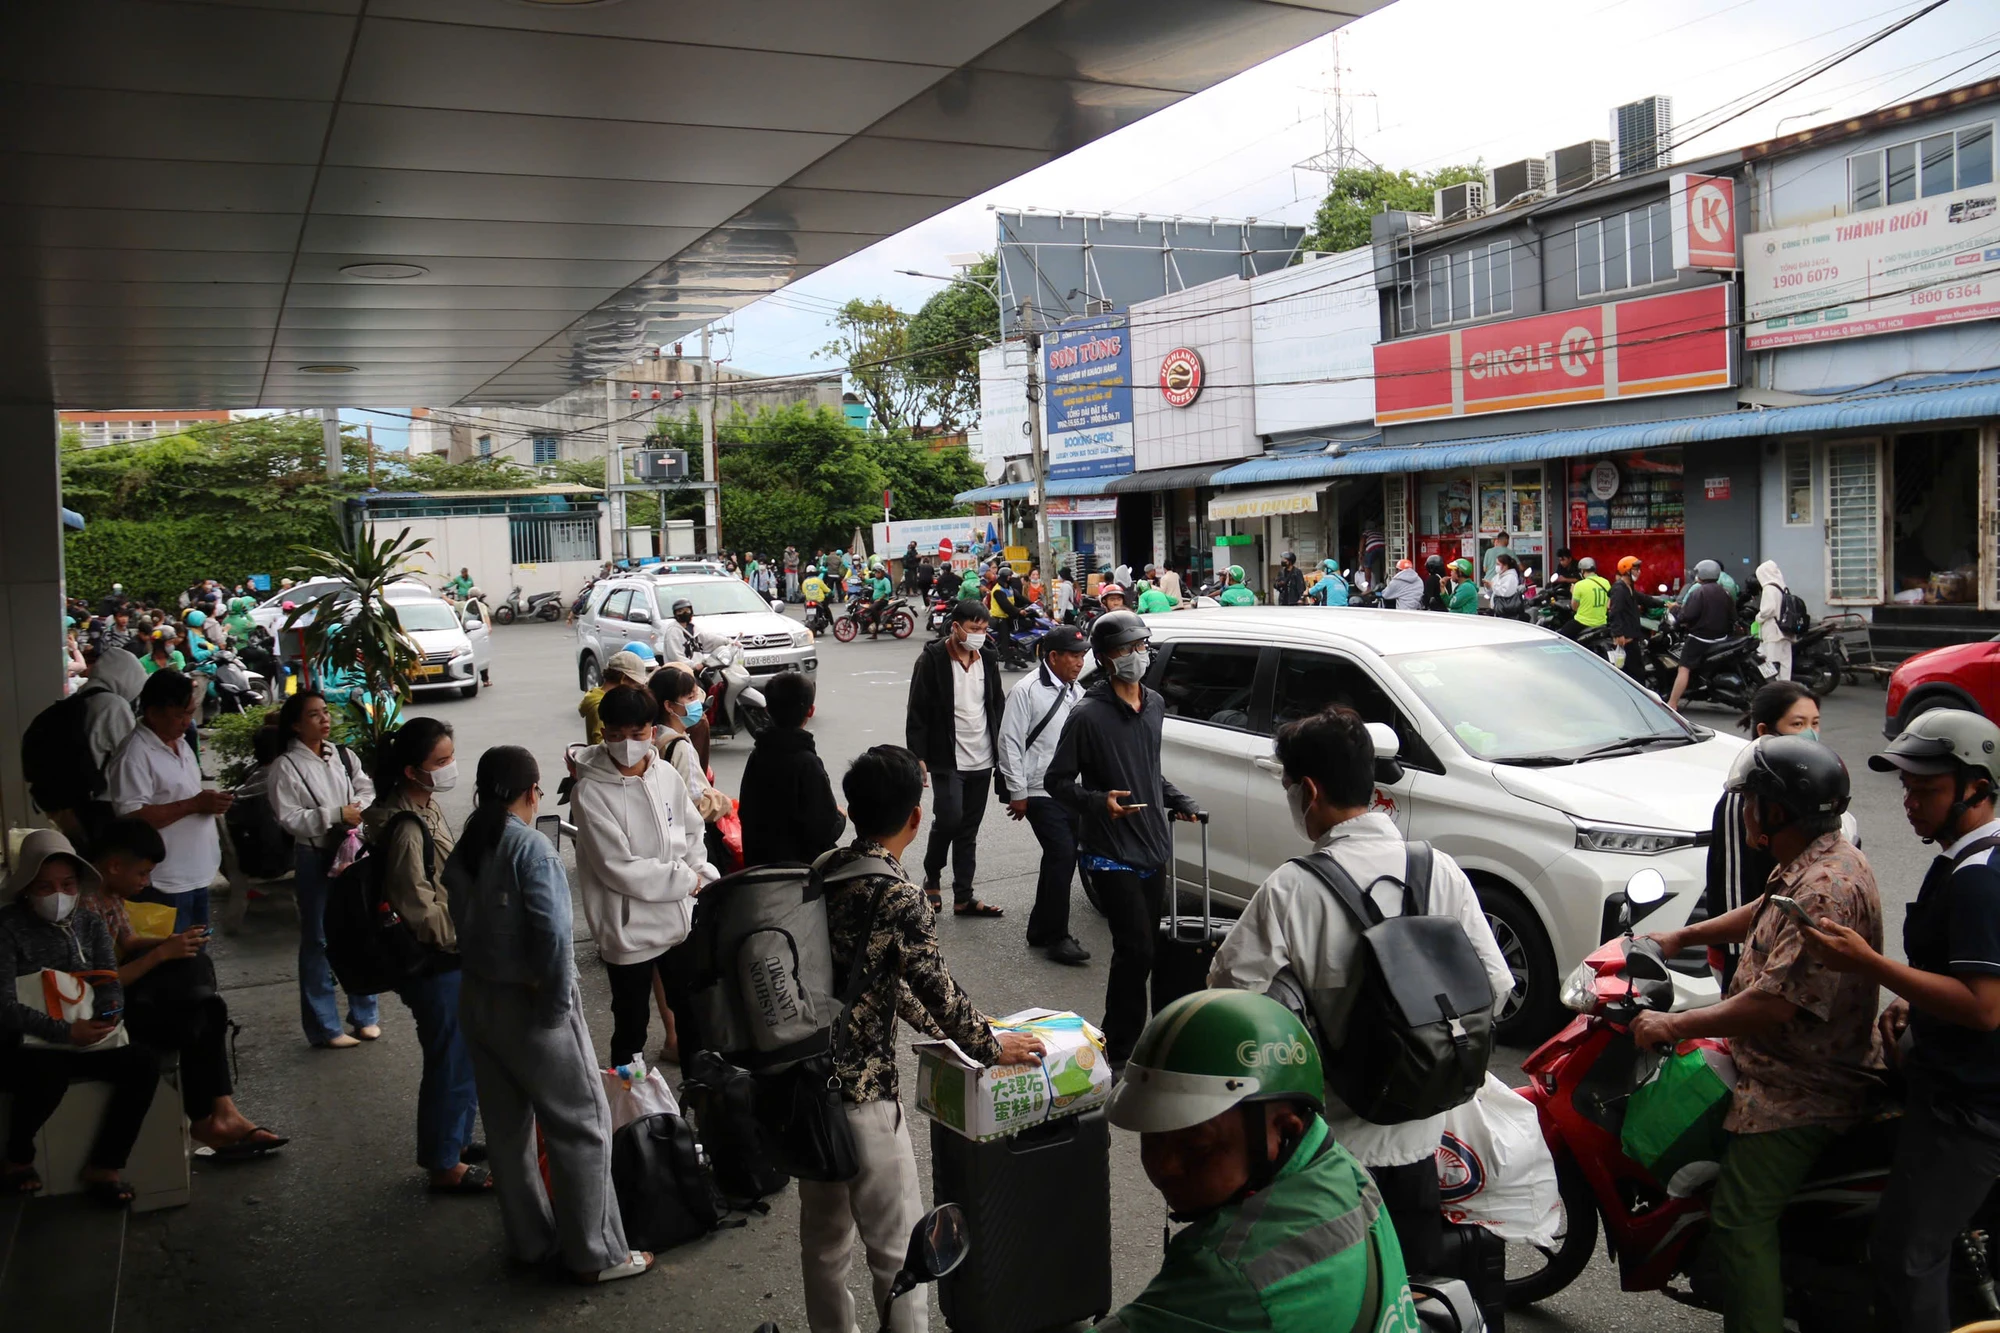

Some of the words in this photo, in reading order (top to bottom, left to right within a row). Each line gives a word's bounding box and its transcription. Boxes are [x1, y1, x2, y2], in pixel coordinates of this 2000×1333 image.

[1836, 219, 1885, 242] THÀNH
[1889, 207, 1929, 232] BƯỞI
[1773, 272, 1803, 289] 1900
[1807, 266, 1839, 283] 6079
[1910, 290, 1942, 306] 1800
[1947, 284, 1982, 300] 6364
[1079, 336, 1121, 363] TÙNG
[1469, 341, 1553, 380] CIRCLE
[1563, 331, 1594, 374] K
[1161, 351, 1198, 378] HIGHLANDS
[1166, 387, 1195, 403] COFFEE
[1064, 434, 1092, 448] BOOKING
[1093, 431, 1114, 443] OFFICE
[1592, 588, 1605, 608] 10
[749, 961, 778, 1028] FASHION
[765, 956, 798, 1023] LANGMU
[1236, 1034, 1308, 1068] Grab
[991, 1074, 1044, 1101] 大理石
[994, 1096, 1031, 1121] 蛋糕
